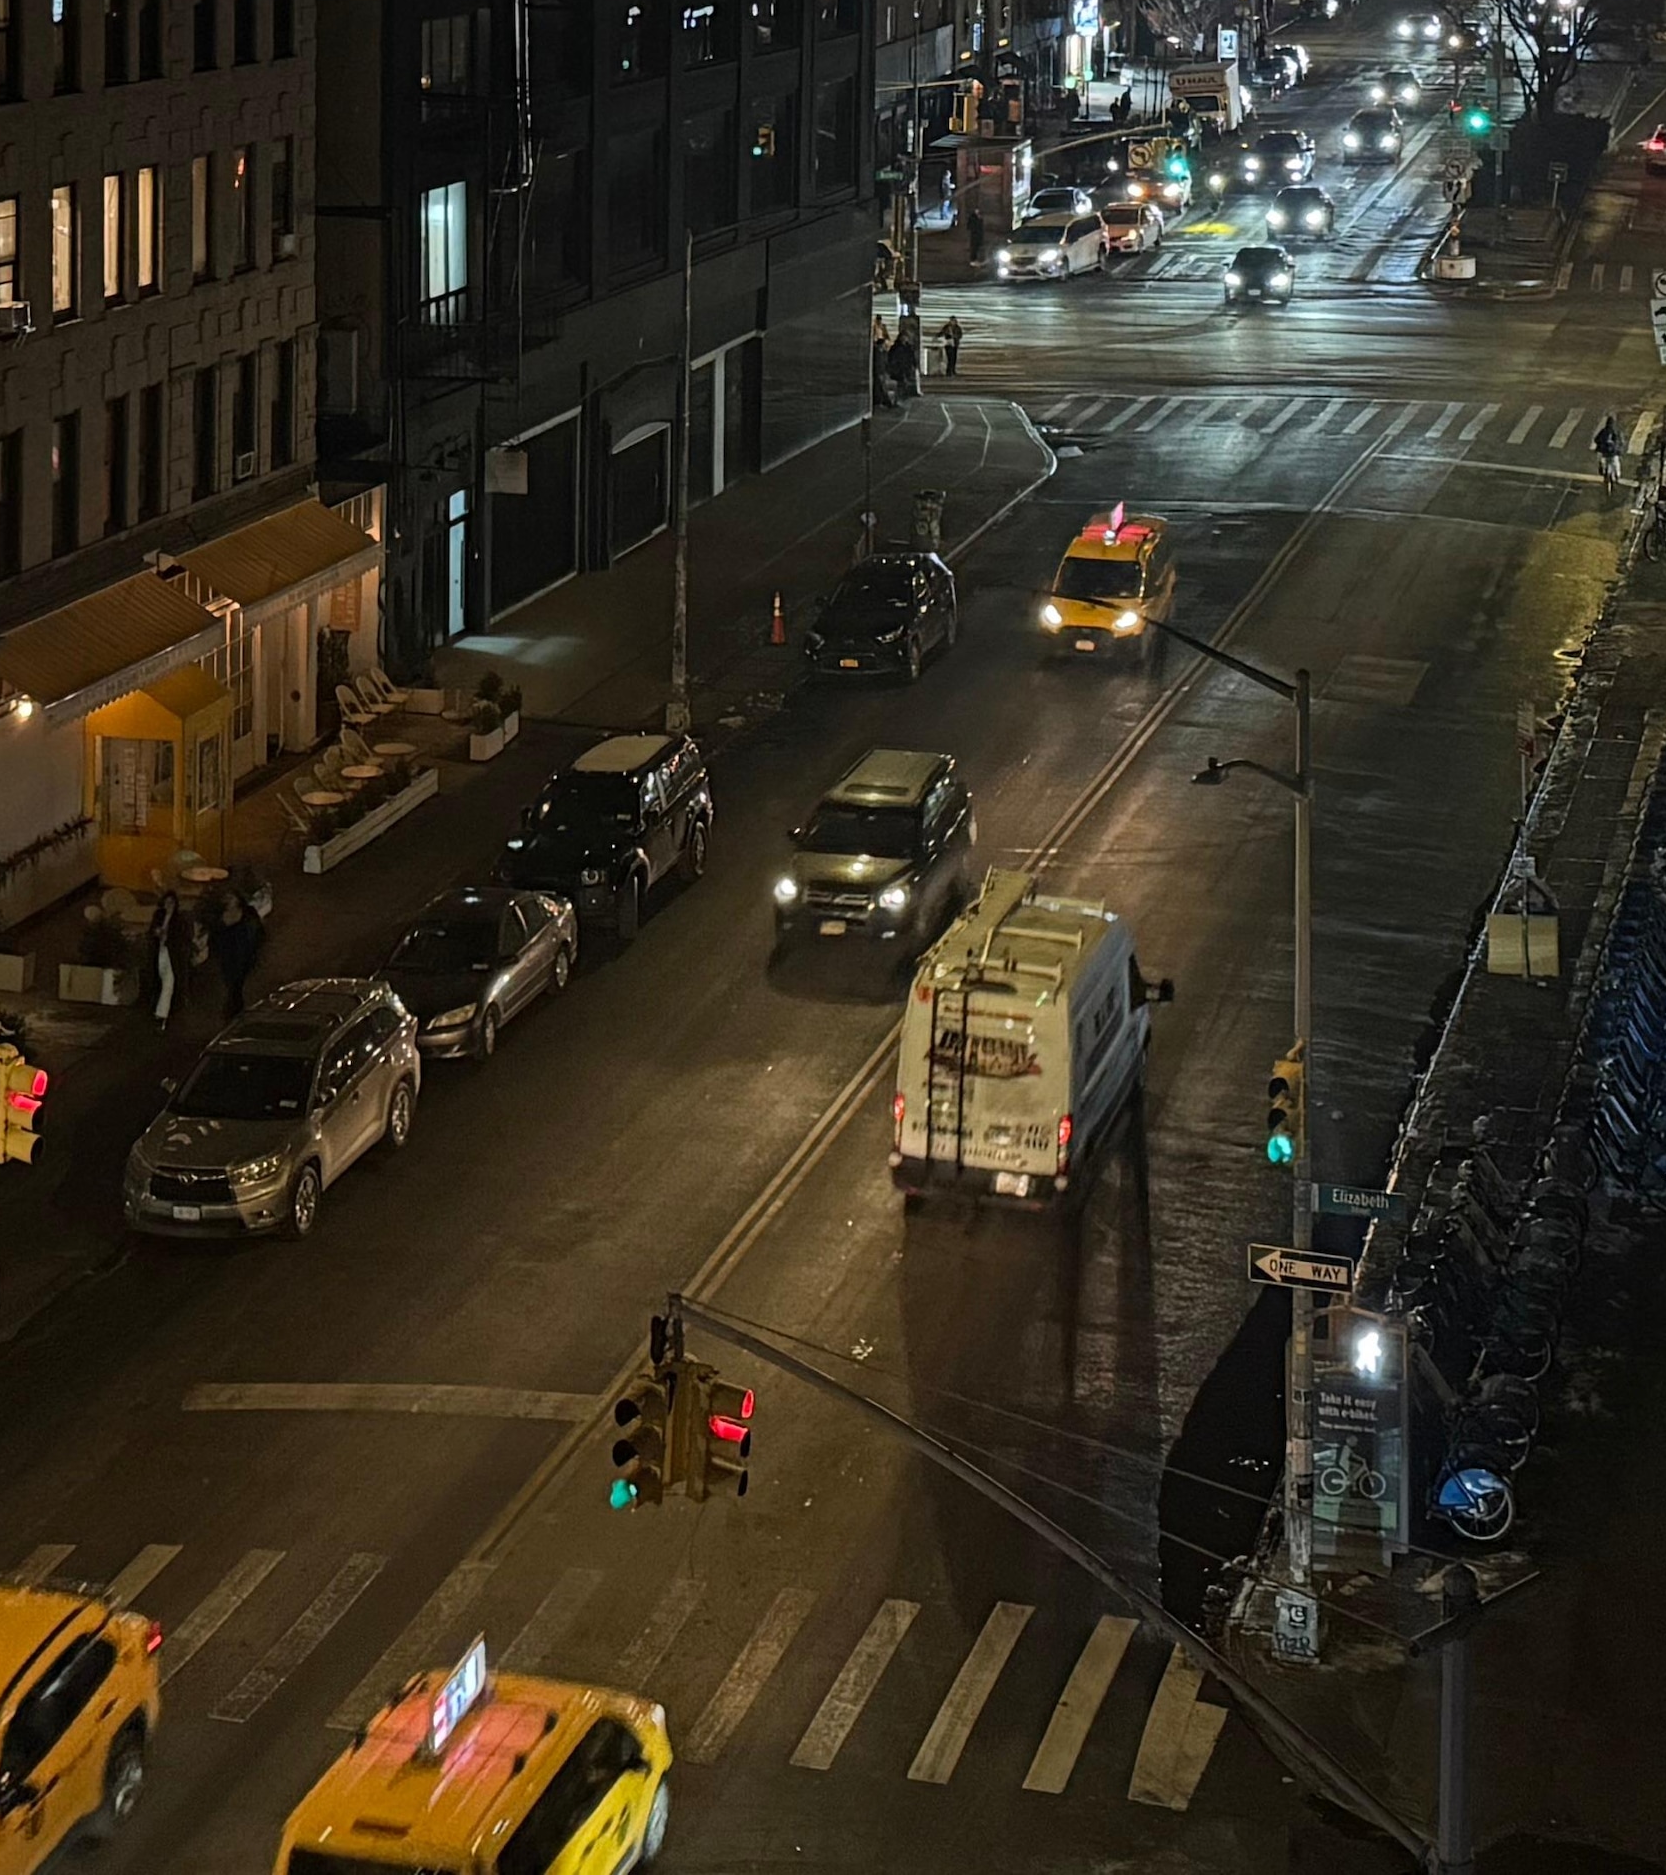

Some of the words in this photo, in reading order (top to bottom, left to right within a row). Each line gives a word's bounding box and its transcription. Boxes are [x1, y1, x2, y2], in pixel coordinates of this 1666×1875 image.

[1332, 1188, 1390, 1209] Elizabeth
[1269, 1259, 1297, 1275] ONE
[1311, 1265, 1342, 1280] WAY
